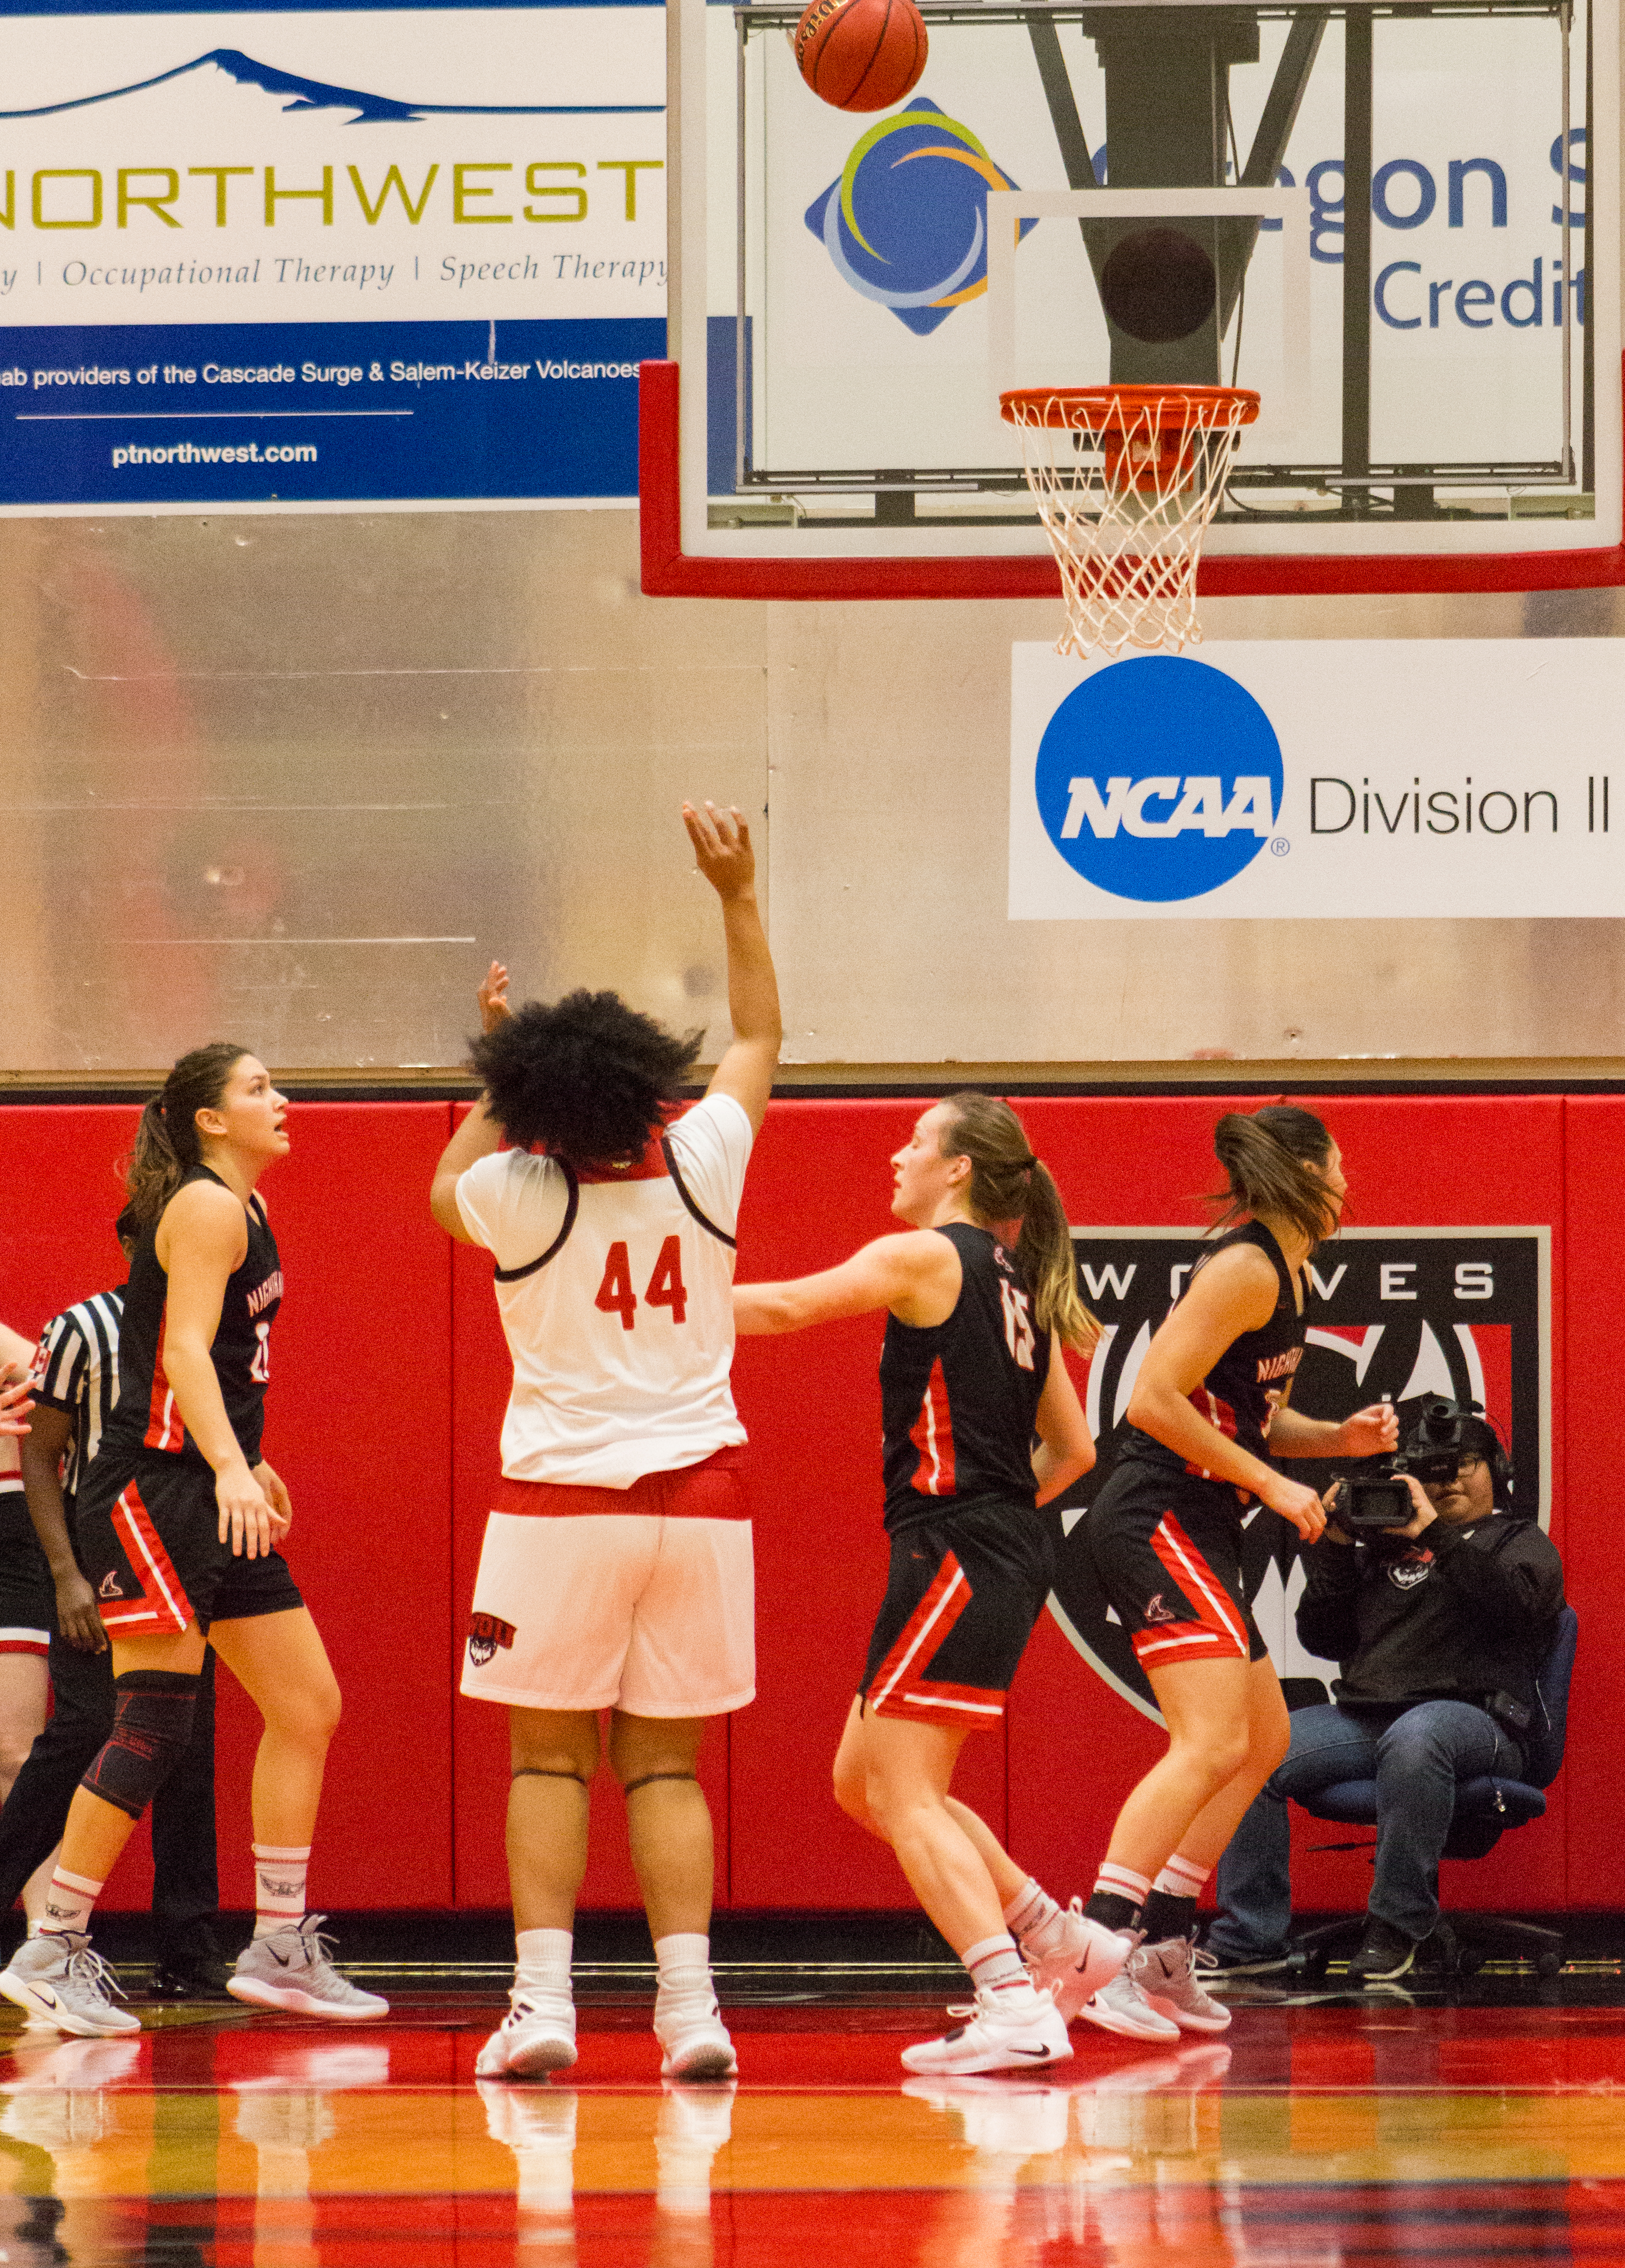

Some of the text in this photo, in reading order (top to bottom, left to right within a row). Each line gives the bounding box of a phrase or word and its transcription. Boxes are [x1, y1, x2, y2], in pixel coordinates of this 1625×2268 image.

[0, 160, 665, 230] ORTHWEST
[63, 258, 260, 293] Occupational
[275, 256, 394, 290] Therapy
[440, 254, 539, 288] Speech
[0, 359, 640, 390] ab providers of the Cascade Surge & Salem-Keizer Volcanoes
[112, 443, 317, 468] ptnorthwest.com
[1060, 776, 1275, 839] NCAA
[1309, 777, 1558, 834] Division
[594, 1235, 688, 1331] 44
[1081, 1262, 1494, 1301] WVES
[999, 1278, 1035, 1372] 15
